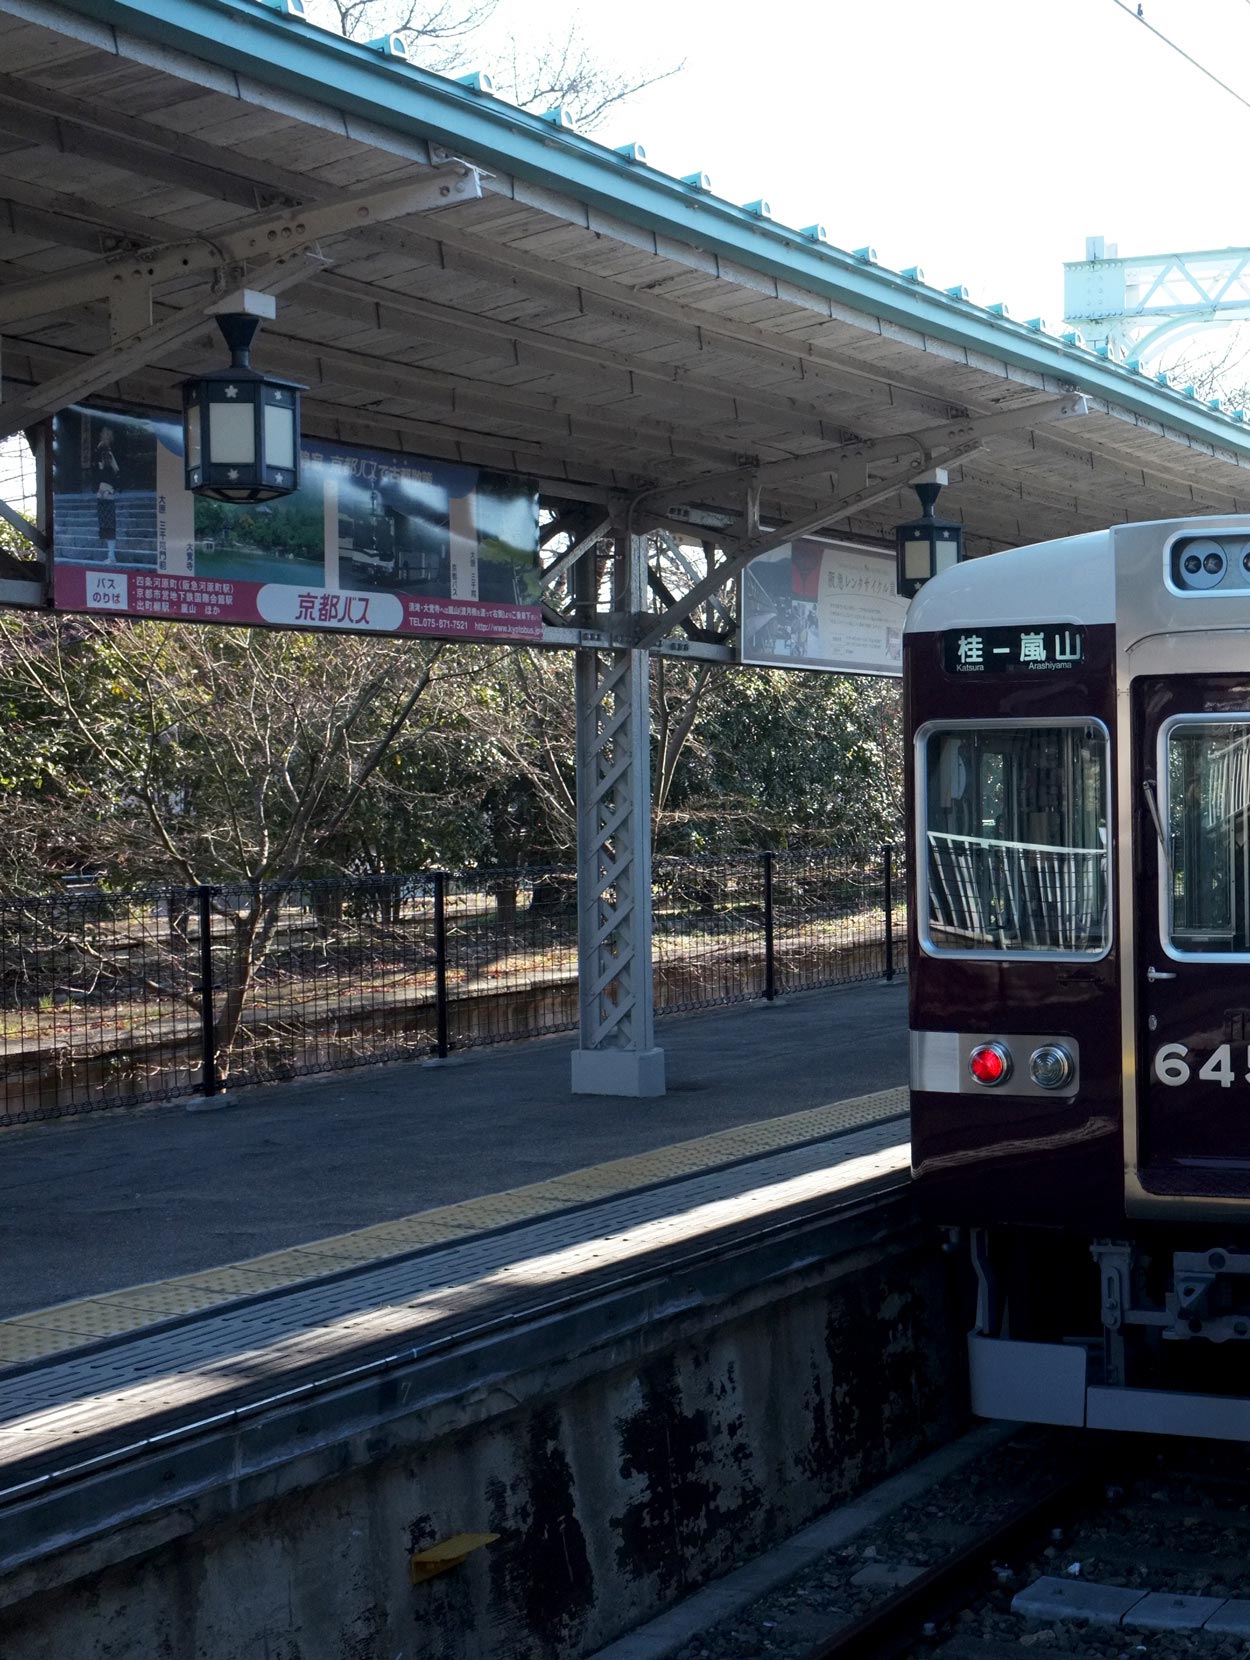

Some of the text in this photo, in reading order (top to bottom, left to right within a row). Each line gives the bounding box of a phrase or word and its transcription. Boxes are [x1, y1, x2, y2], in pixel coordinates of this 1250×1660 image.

[96, 577, 116, 590] バス
[92, 592, 121, 604] のりば
[294, 592, 371, 625] 京都バス
[956, 661, 1072, 672] Katsura Arashiyama
